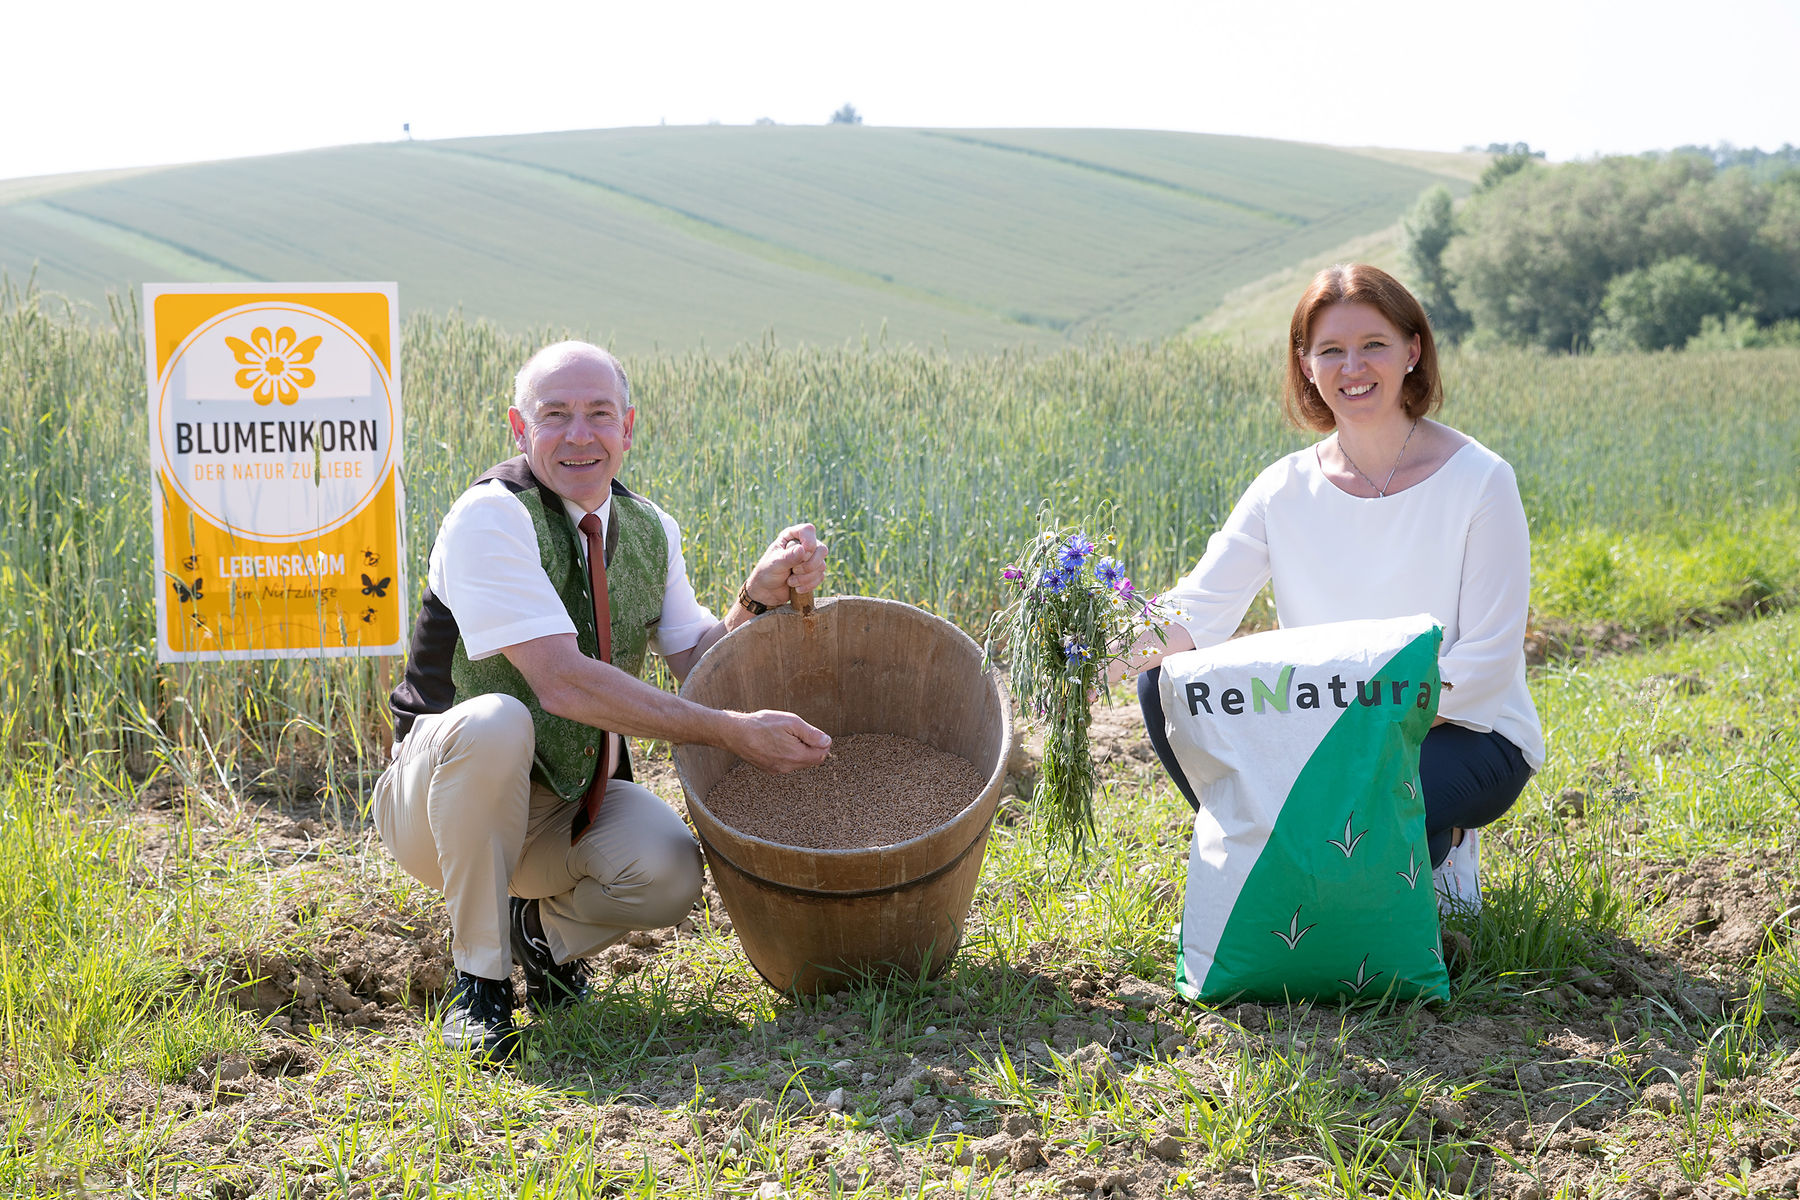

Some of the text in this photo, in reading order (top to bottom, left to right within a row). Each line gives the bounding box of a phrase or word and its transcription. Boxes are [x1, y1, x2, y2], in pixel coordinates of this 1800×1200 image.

[176, 420, 378, 454] BLUMENKORN
[194, 461, 363, 481] DER NATUR ZU LIEBE
[218, 553, 345, 578] LEBENSRAUM
[230, 584, 253, 600] ür
[1185, 664, 1432, 717] ReNatura
